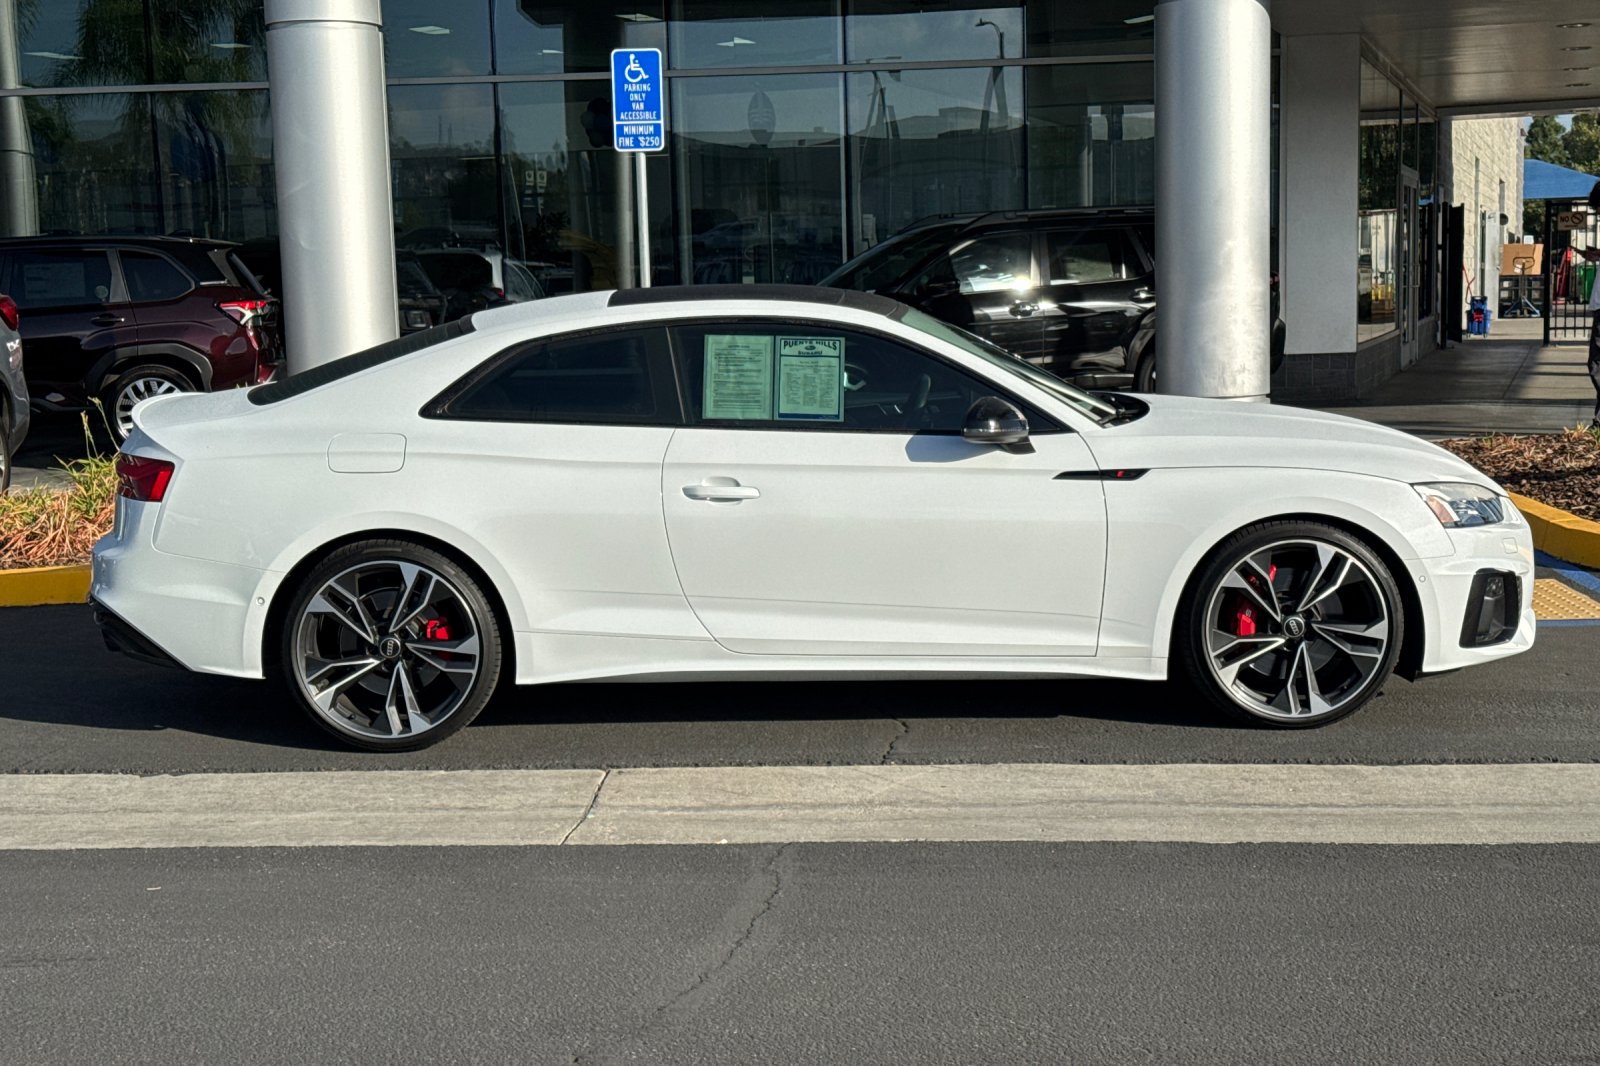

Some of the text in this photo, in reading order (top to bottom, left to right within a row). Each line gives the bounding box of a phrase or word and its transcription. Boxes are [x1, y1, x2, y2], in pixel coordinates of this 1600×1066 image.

[624, 84, 651, 92] PARKING
[630, 93, 646, 101] ONLY
[620, 111, 657, 120] ACCESSIBLE
[623, 125, 654, 135] MINIMUM
[618, 136, 660, 147] FINE $250
[783, 340, 837, 351] PUENTE HILLS
